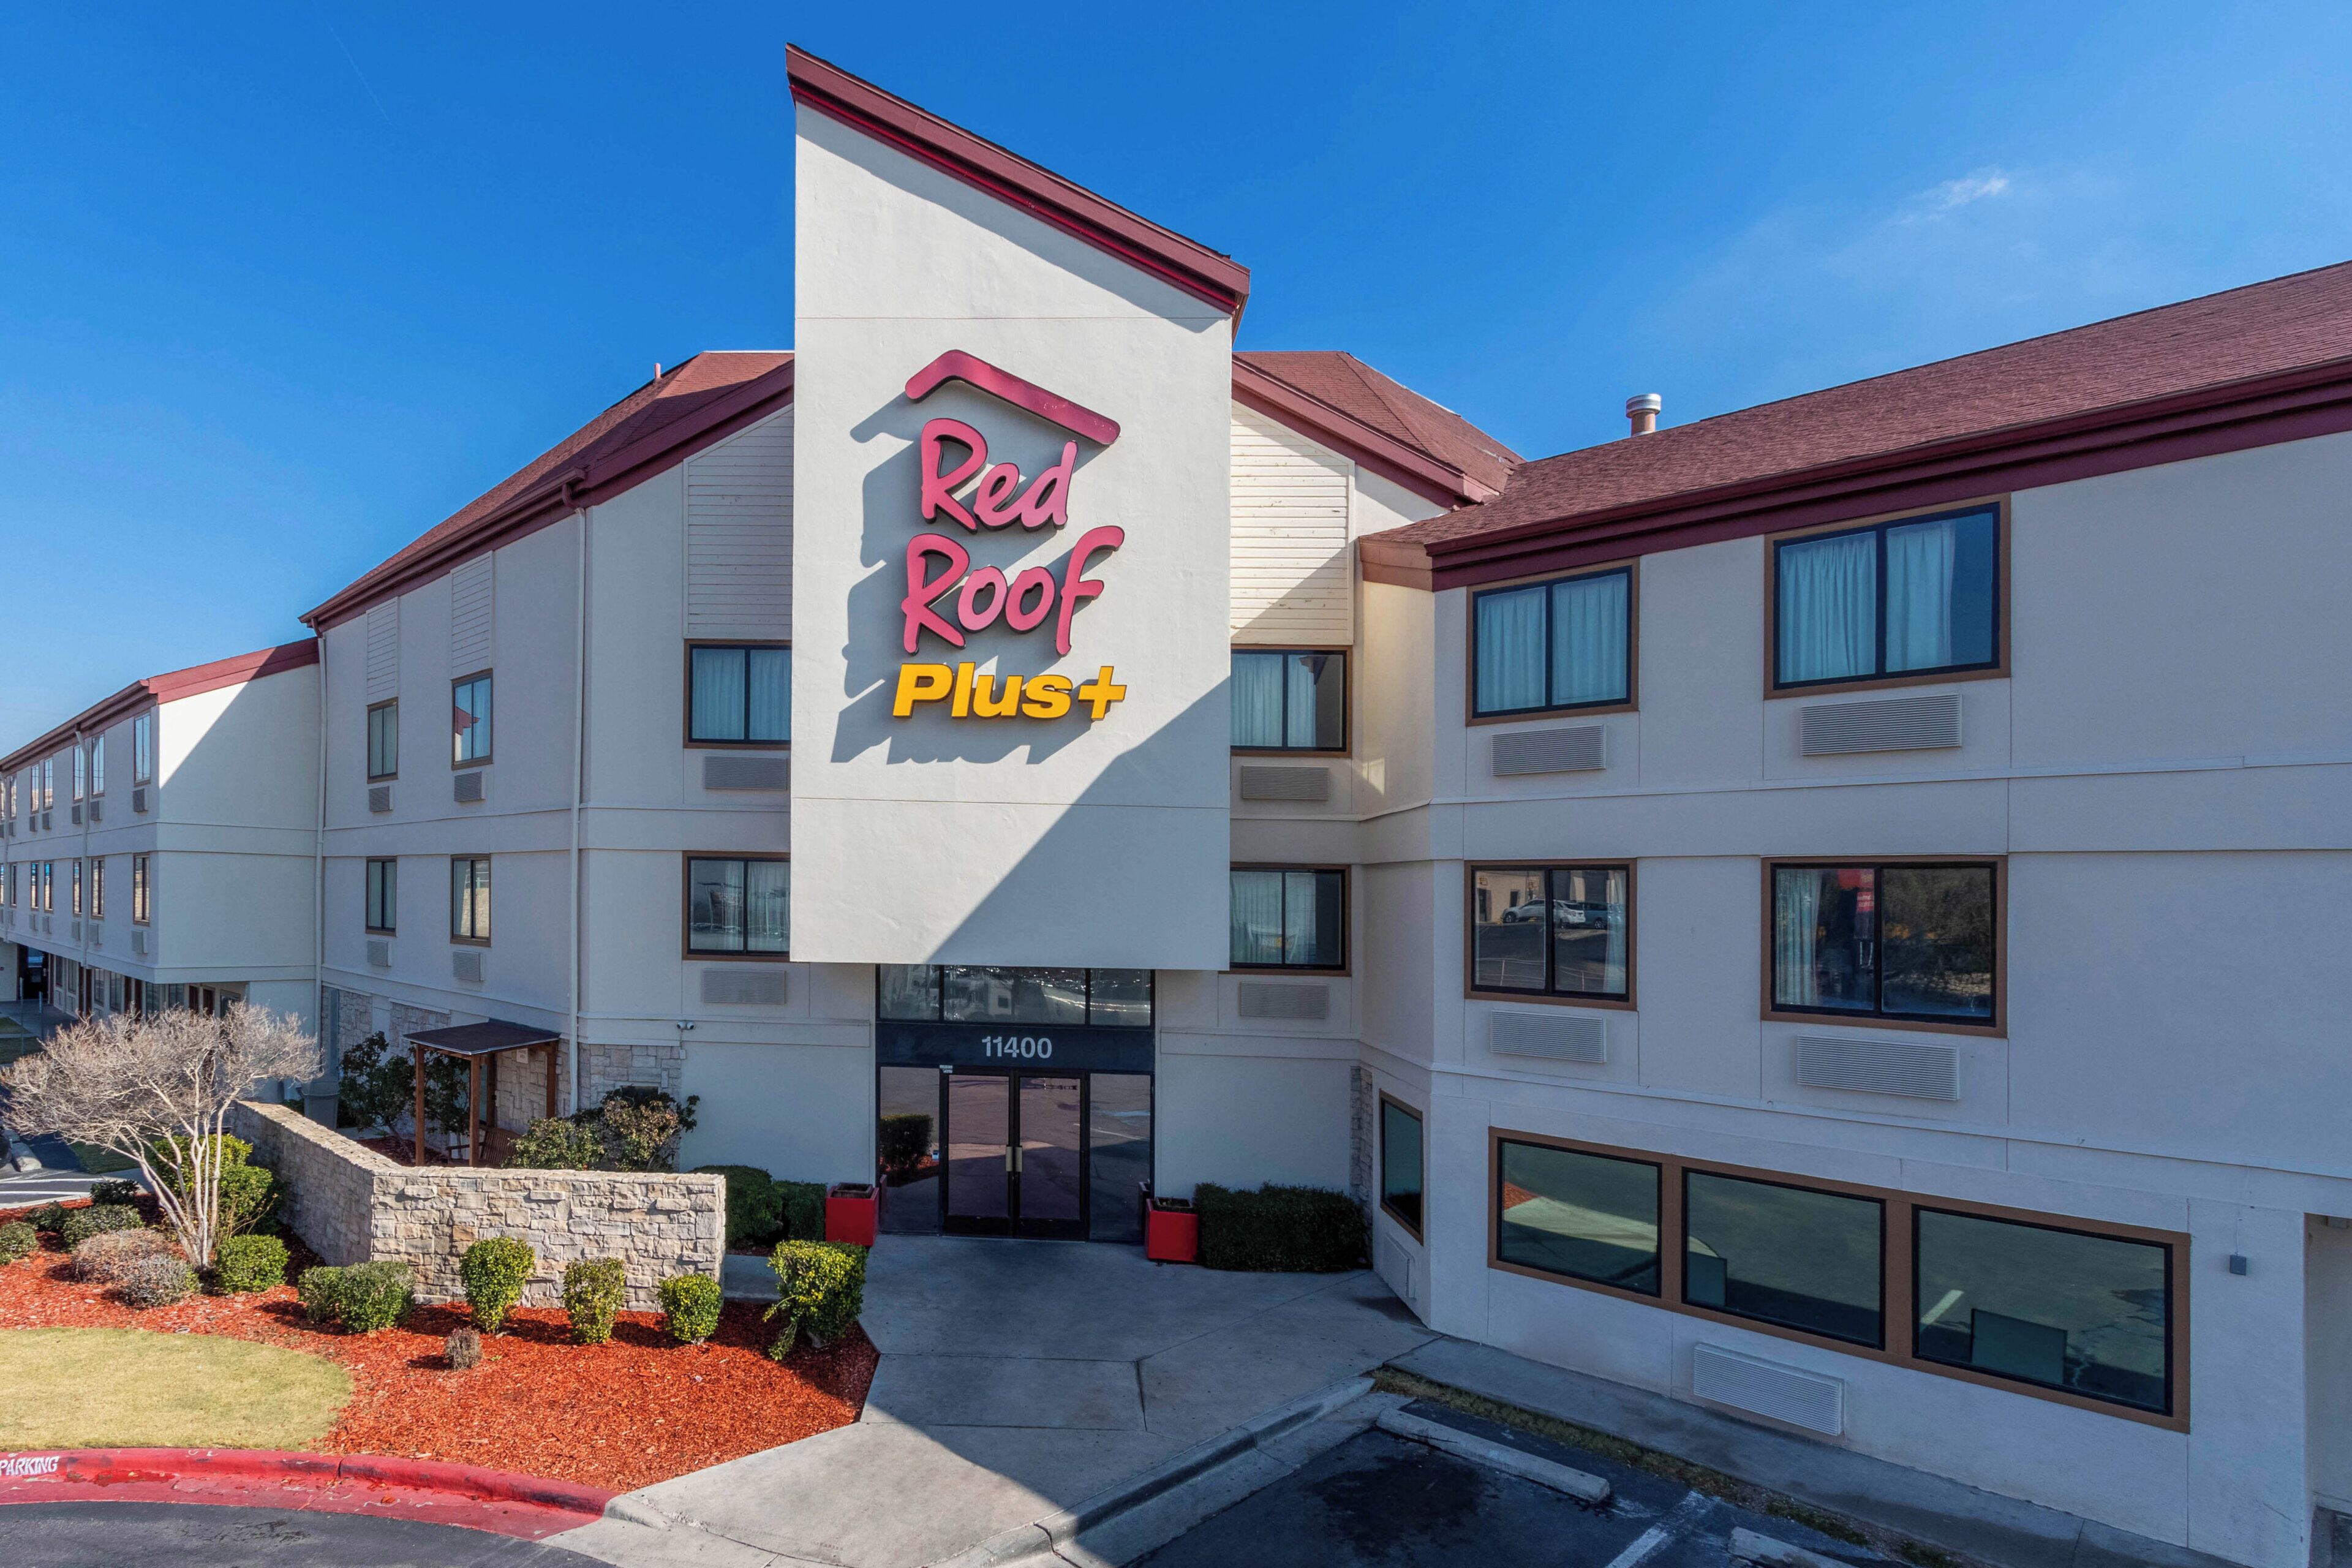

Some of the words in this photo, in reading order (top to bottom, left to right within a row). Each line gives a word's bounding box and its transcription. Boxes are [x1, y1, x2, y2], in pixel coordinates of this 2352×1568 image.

[921, 418, 1079, 533] Red
[901, 526, 1125, 657] Roof
[892, 662, 1127, 721] Plus+
[981, 1036, 1052, 1059] 11400
[0, 1455, 59, 1477] PARKING
